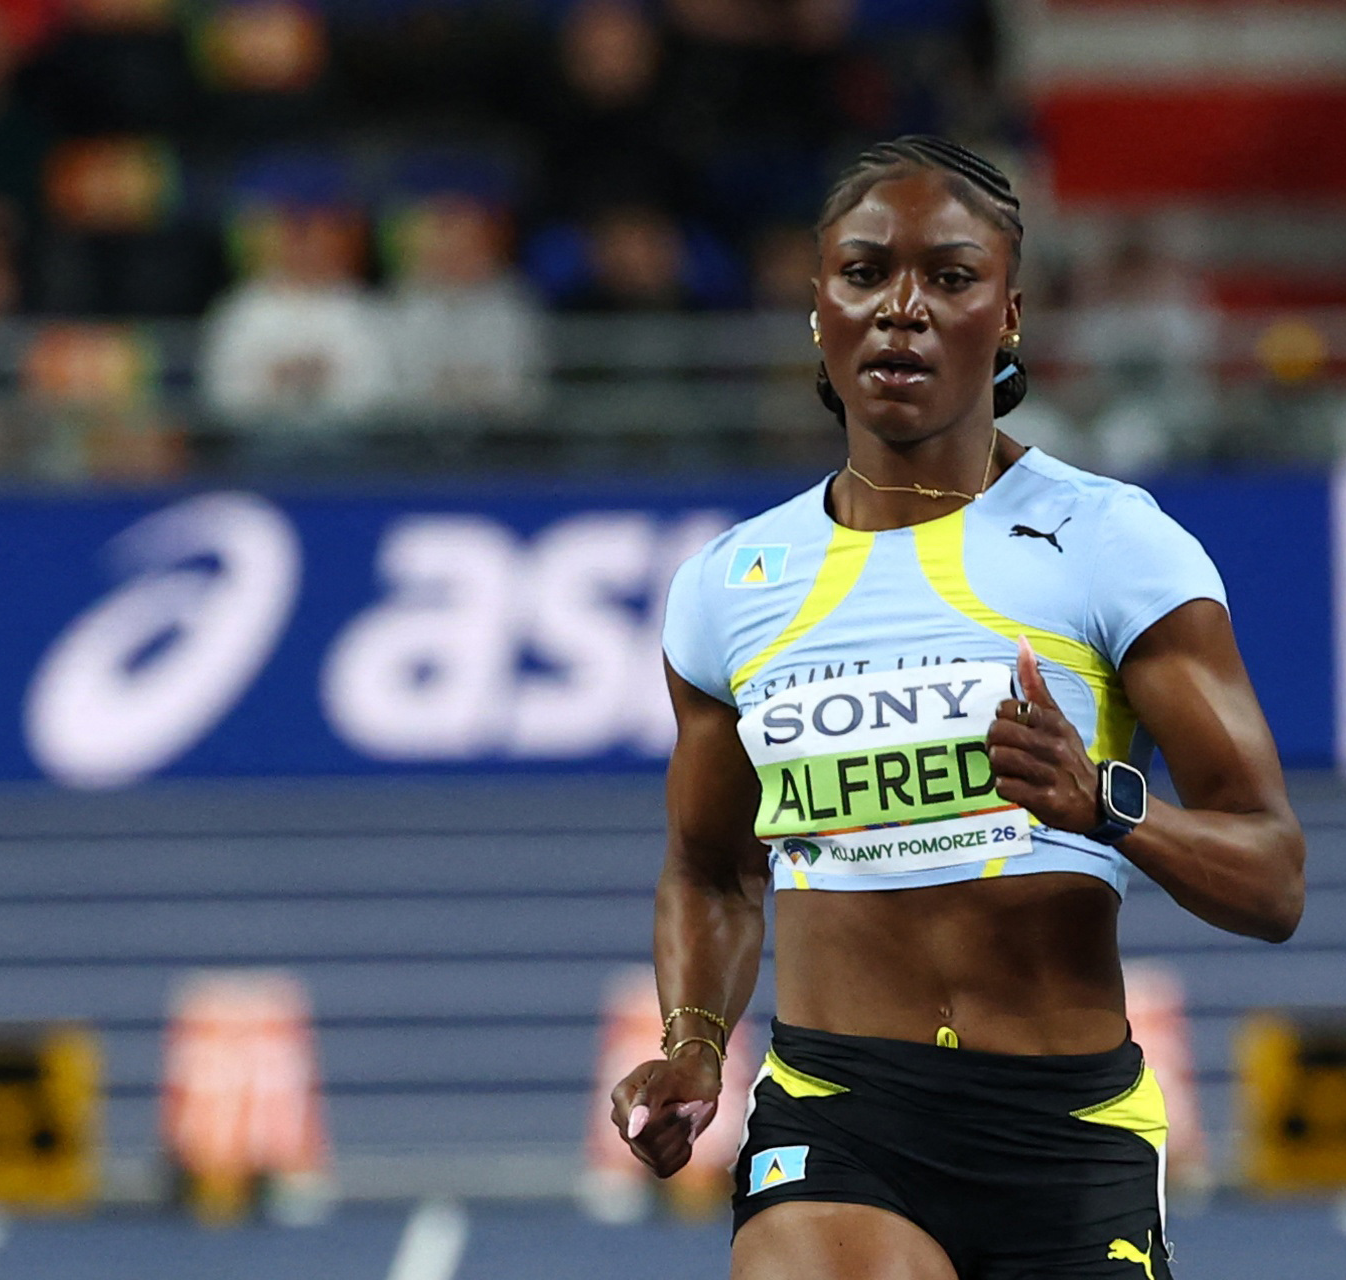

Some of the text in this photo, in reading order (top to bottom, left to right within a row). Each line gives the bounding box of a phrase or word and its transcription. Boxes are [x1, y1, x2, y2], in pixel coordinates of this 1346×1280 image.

[762, 679, 982, 746] SONY
[770, 741, 997, 825] ALFRED
[829, 826, 1017, 862] KUJAWY POMORZE 26
